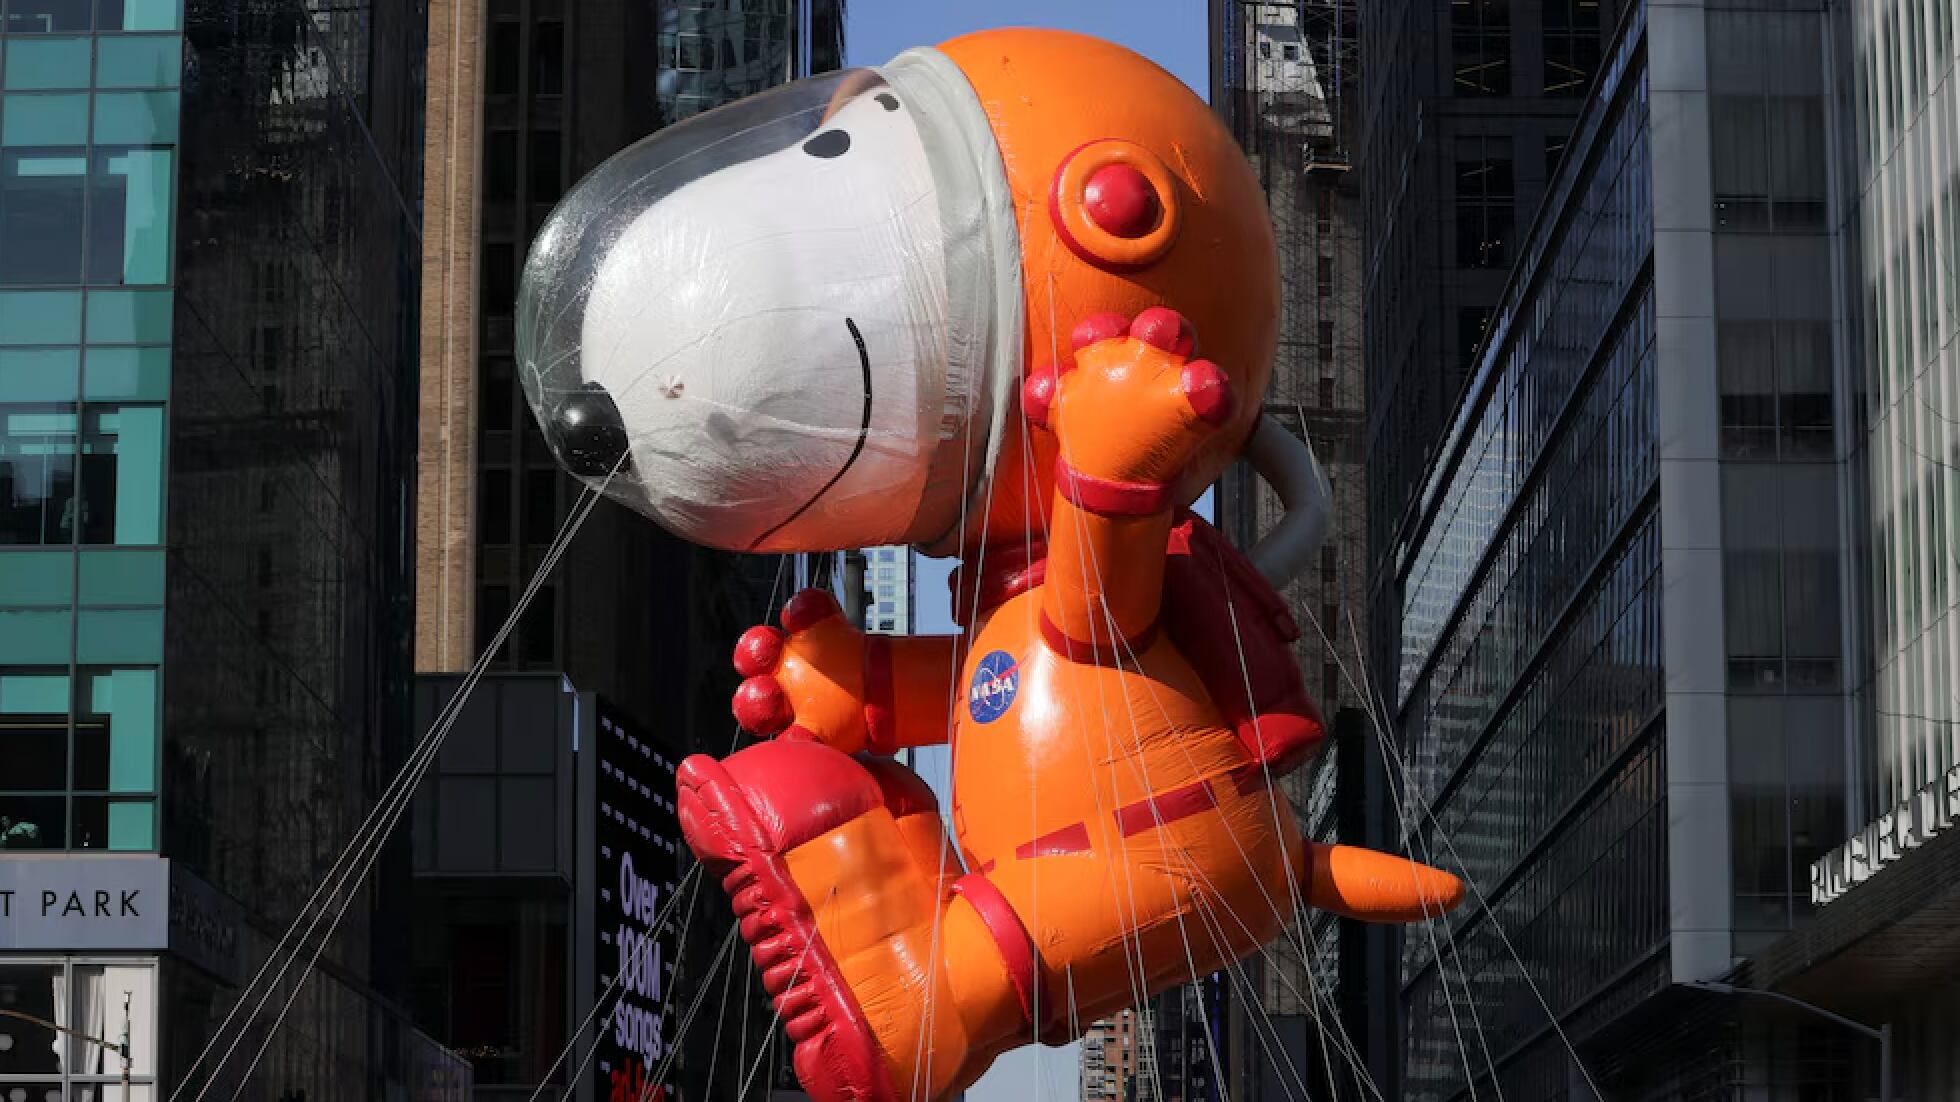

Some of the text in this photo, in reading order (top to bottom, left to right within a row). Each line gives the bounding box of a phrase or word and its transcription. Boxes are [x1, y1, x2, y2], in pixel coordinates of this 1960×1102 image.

[970, 676, 1015, 701] NASA
[41, 889, 141, 917] PARK
[620, 851, 658, 925] Over
[616, 924, 661, 1002] 100M
[614, 1000, 662, 1070] songs
